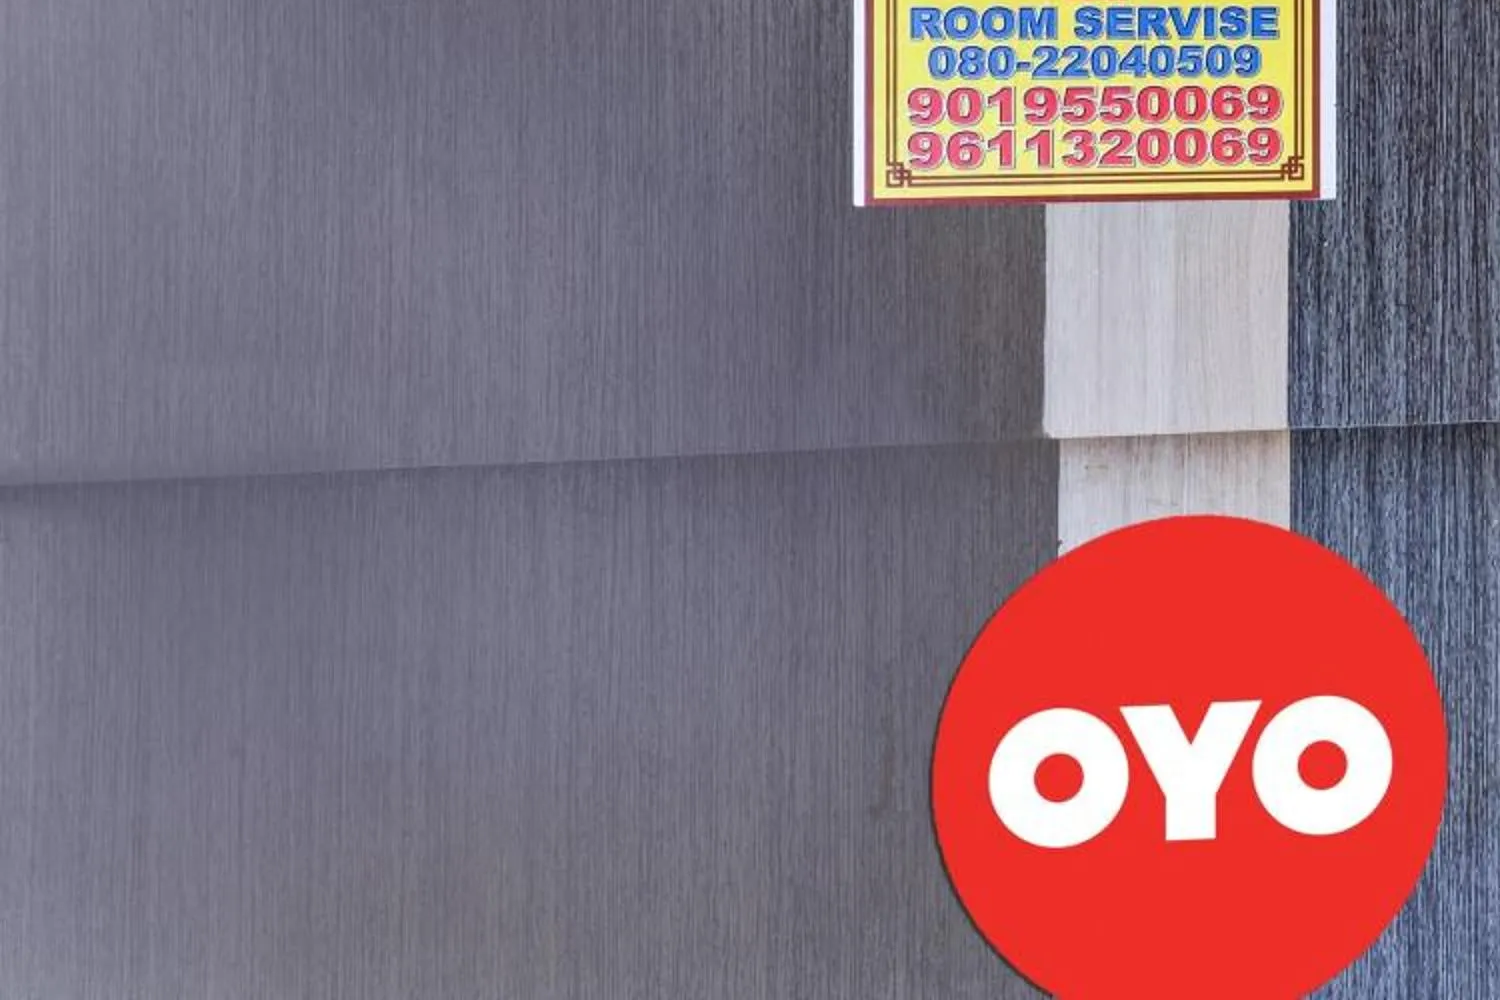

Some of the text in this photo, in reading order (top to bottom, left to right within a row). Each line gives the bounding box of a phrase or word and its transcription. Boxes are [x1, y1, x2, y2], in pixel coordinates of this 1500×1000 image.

[909, 6, 1281, 40] ROOM SERVISE
[928, 45, 1262, 80] 080-22040509
[907, 84, 1283, 126] 9019550069
[907, 127, 1283, 169] 9611320069
[988, 695, 1393, 849] OYO
